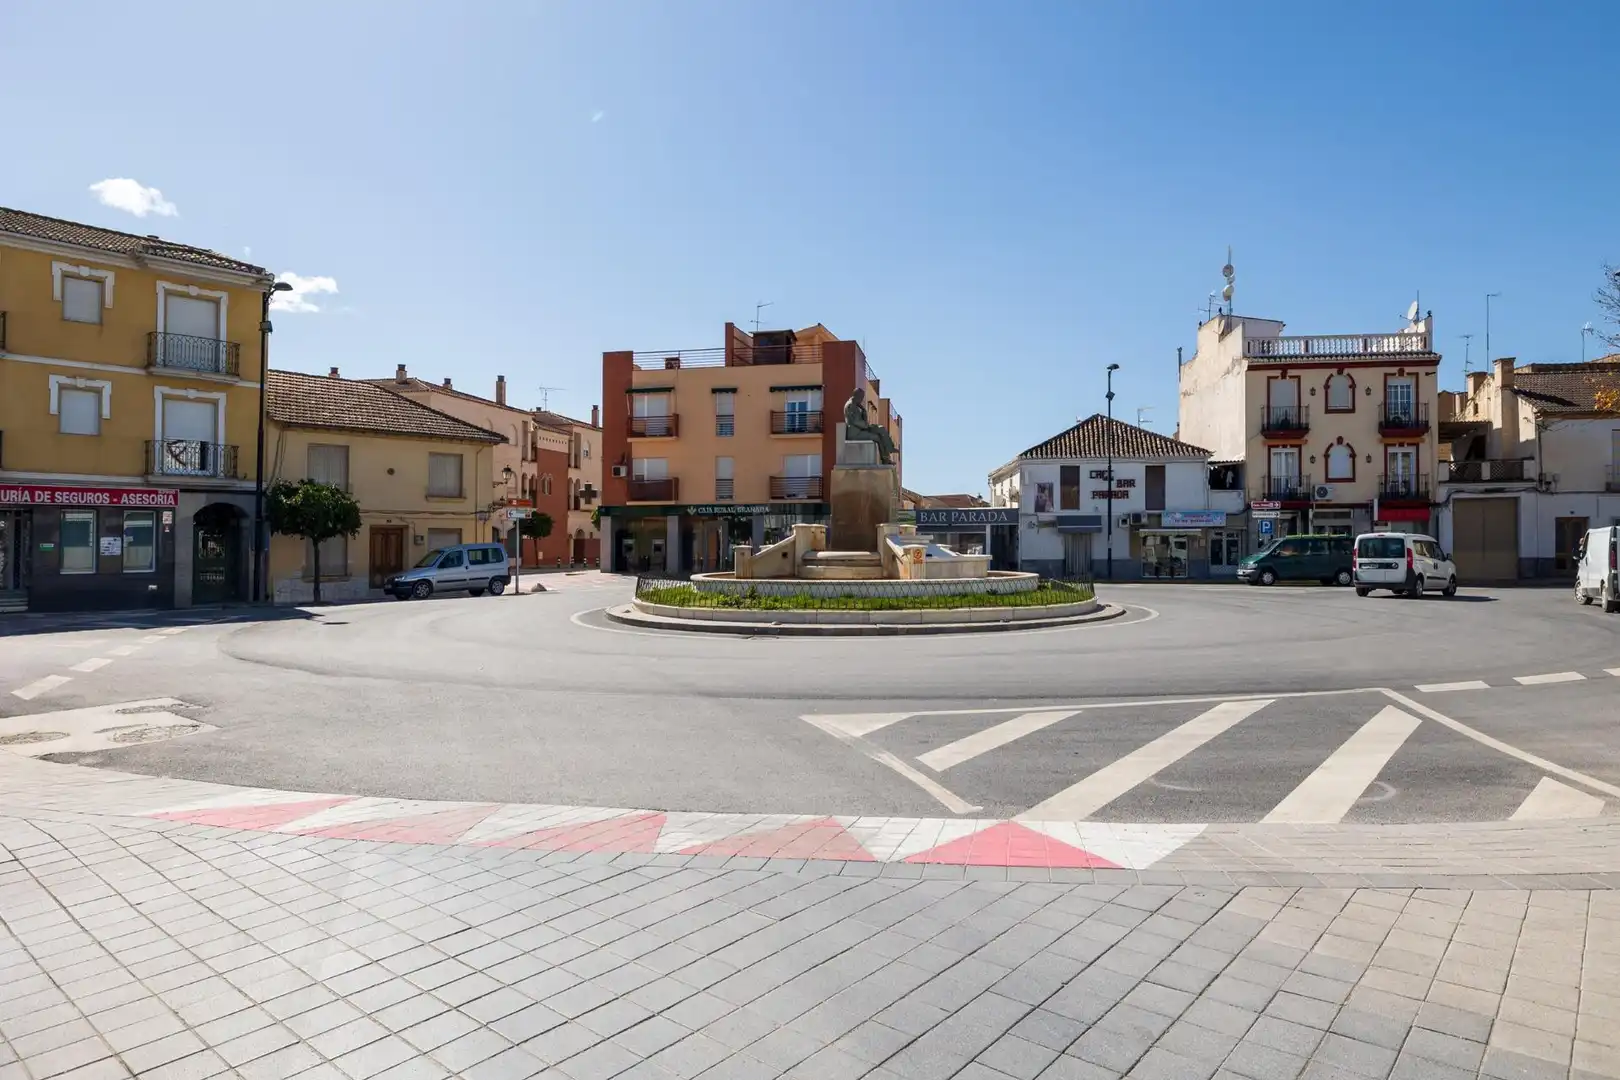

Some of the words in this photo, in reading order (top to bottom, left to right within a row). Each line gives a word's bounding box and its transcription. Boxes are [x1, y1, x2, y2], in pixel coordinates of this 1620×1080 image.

[1116, 479, 1136, 488] BAR
[35, 490, 52, 503] DE
[54, 491, 110, 504] SEGUROS
[920, 511, 946, 522] BAR
[951, 511, 1008, 522] PARADA
[1262, 521, 1271, 533] P
